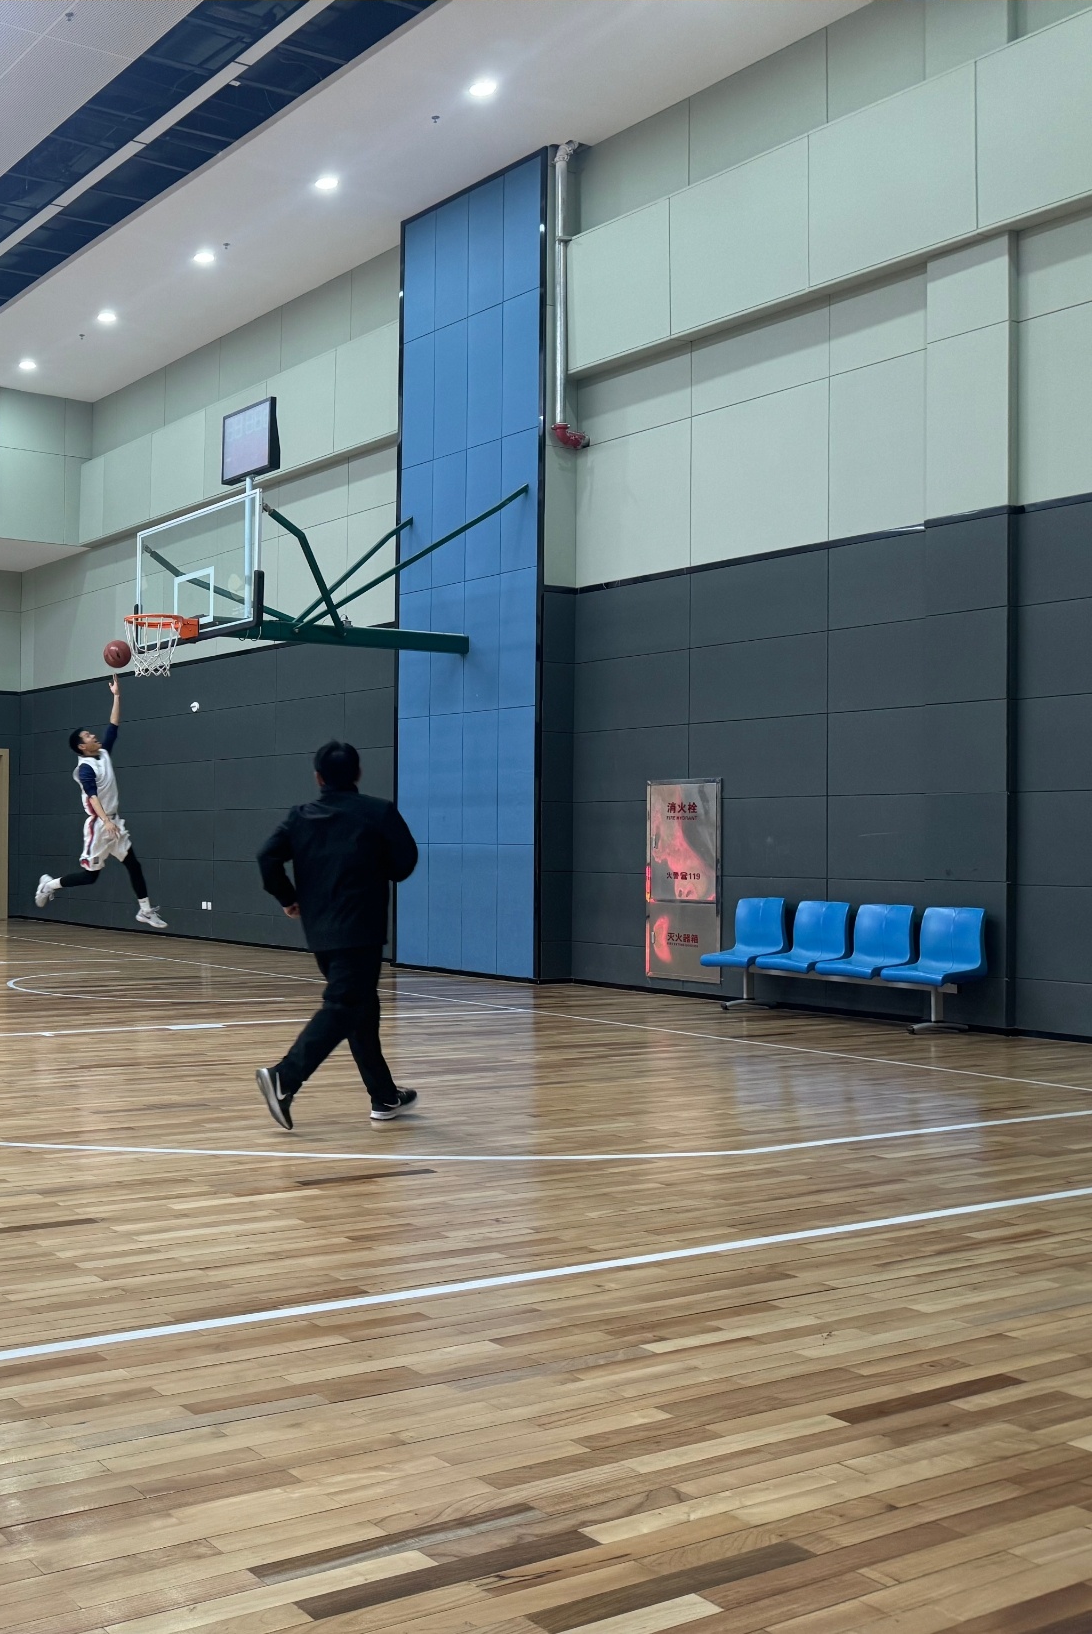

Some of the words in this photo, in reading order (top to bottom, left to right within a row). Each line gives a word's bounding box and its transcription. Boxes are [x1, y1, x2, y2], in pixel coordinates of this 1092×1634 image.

[667, 802, 698, 813] 消火栓
[689, 872, 701, 880] 119
[667, 933, 699, 944] 灭火器箱
